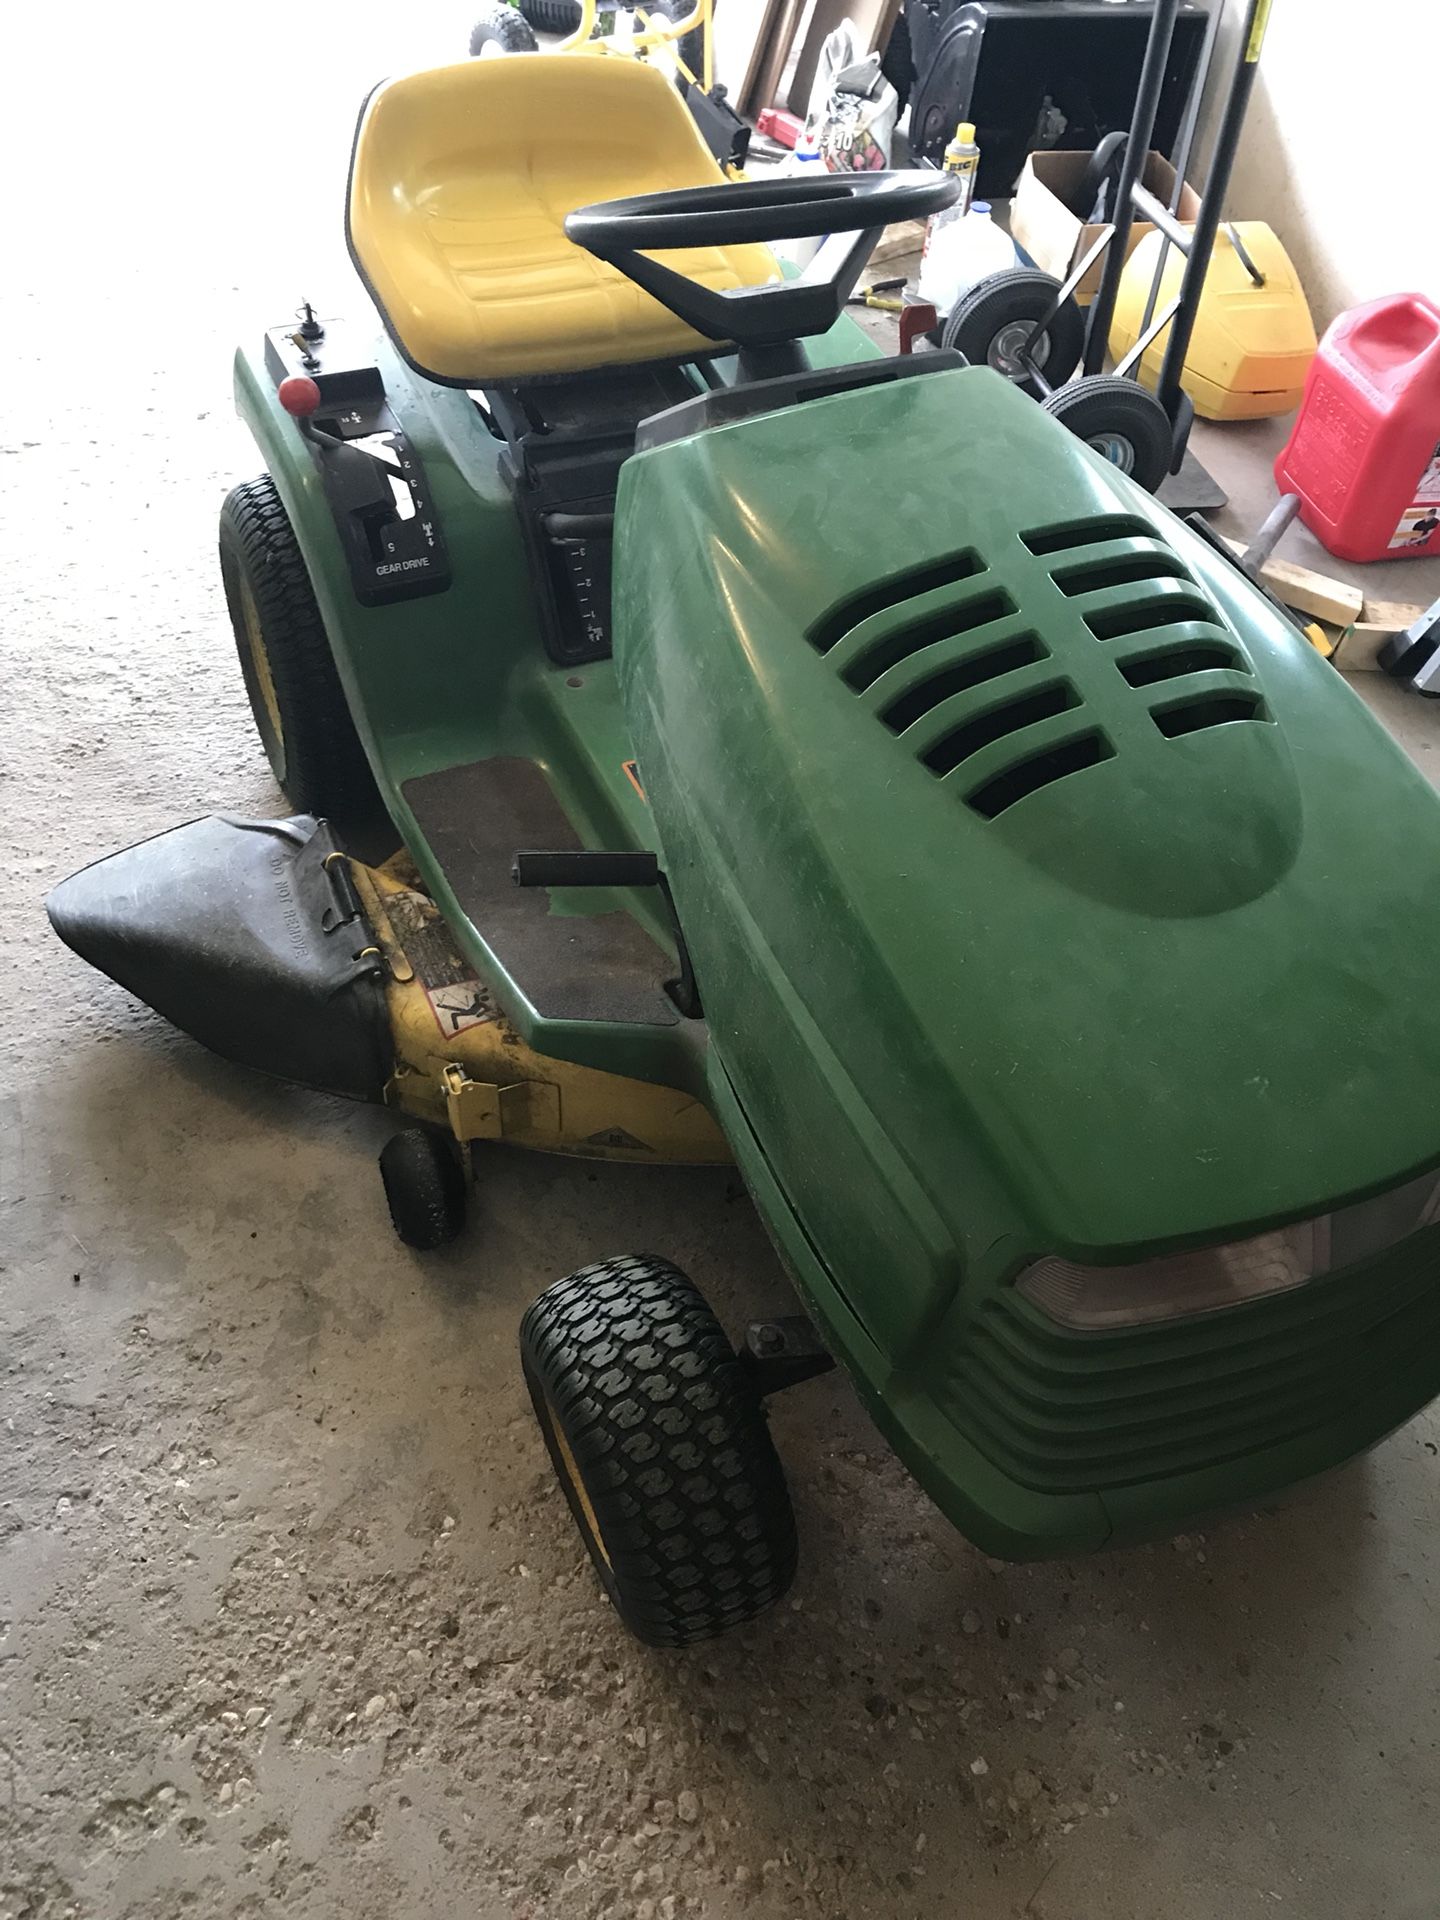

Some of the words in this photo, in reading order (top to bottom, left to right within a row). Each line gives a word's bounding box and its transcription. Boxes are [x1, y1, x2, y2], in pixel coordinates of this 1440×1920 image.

[404, 461, 411, 469] 2
[410, 479, 418, 487] 3
[416, 500, 423, 508] 4
[388, 542, 396, 552] 5
[580, 548, 586, 556] 3
[376, 562, 402, 576] GEAR
[402, 556, 430, 570] DRIVE
[585, 578, 592, 587] 2
[270, 856, 284, 876] DO
[275, 880, 293, 903] NOT
[283, 909, 309, 959] REMOVE
